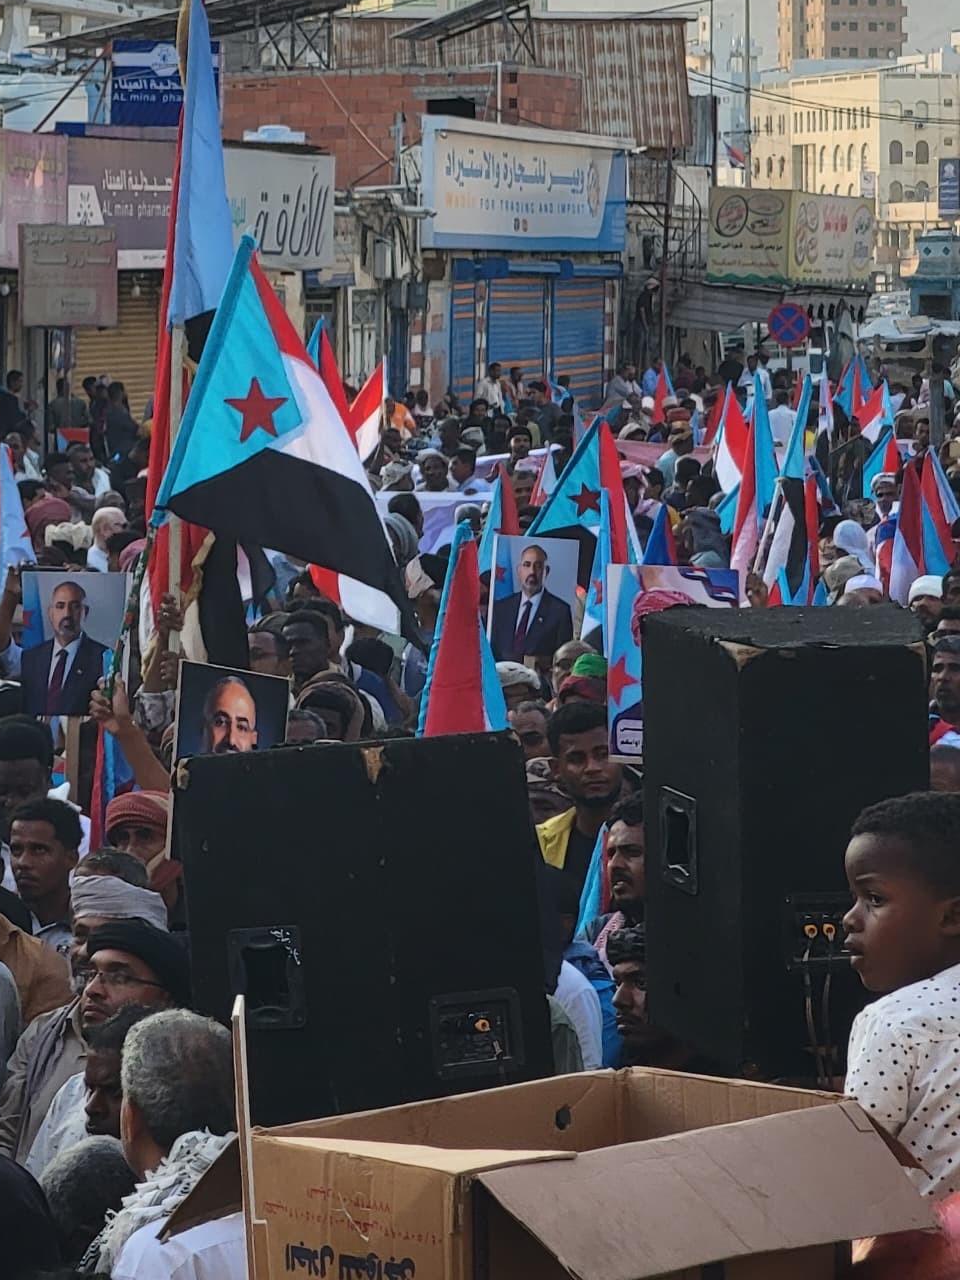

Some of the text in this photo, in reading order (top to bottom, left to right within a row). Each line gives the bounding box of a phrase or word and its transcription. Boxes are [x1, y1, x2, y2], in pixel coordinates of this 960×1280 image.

[113, 78, 148, 93] الميناء
[112, 93, 127, 102] AL
[129, 92, 156, 102] mina
[445, 148, 501, 188] والاستيراد
[102, 168, 127, 197] الميناء
[102, 199, 172, 221] AL mina pharmac
[479, 197, 496, 211] FOR
[500, 199, 535, 215] TRADING
[538, 201, 554, 215] AND
[557, 202, 586, 216] IMPORT
[285, 1241, 335, 1279] الجلال
